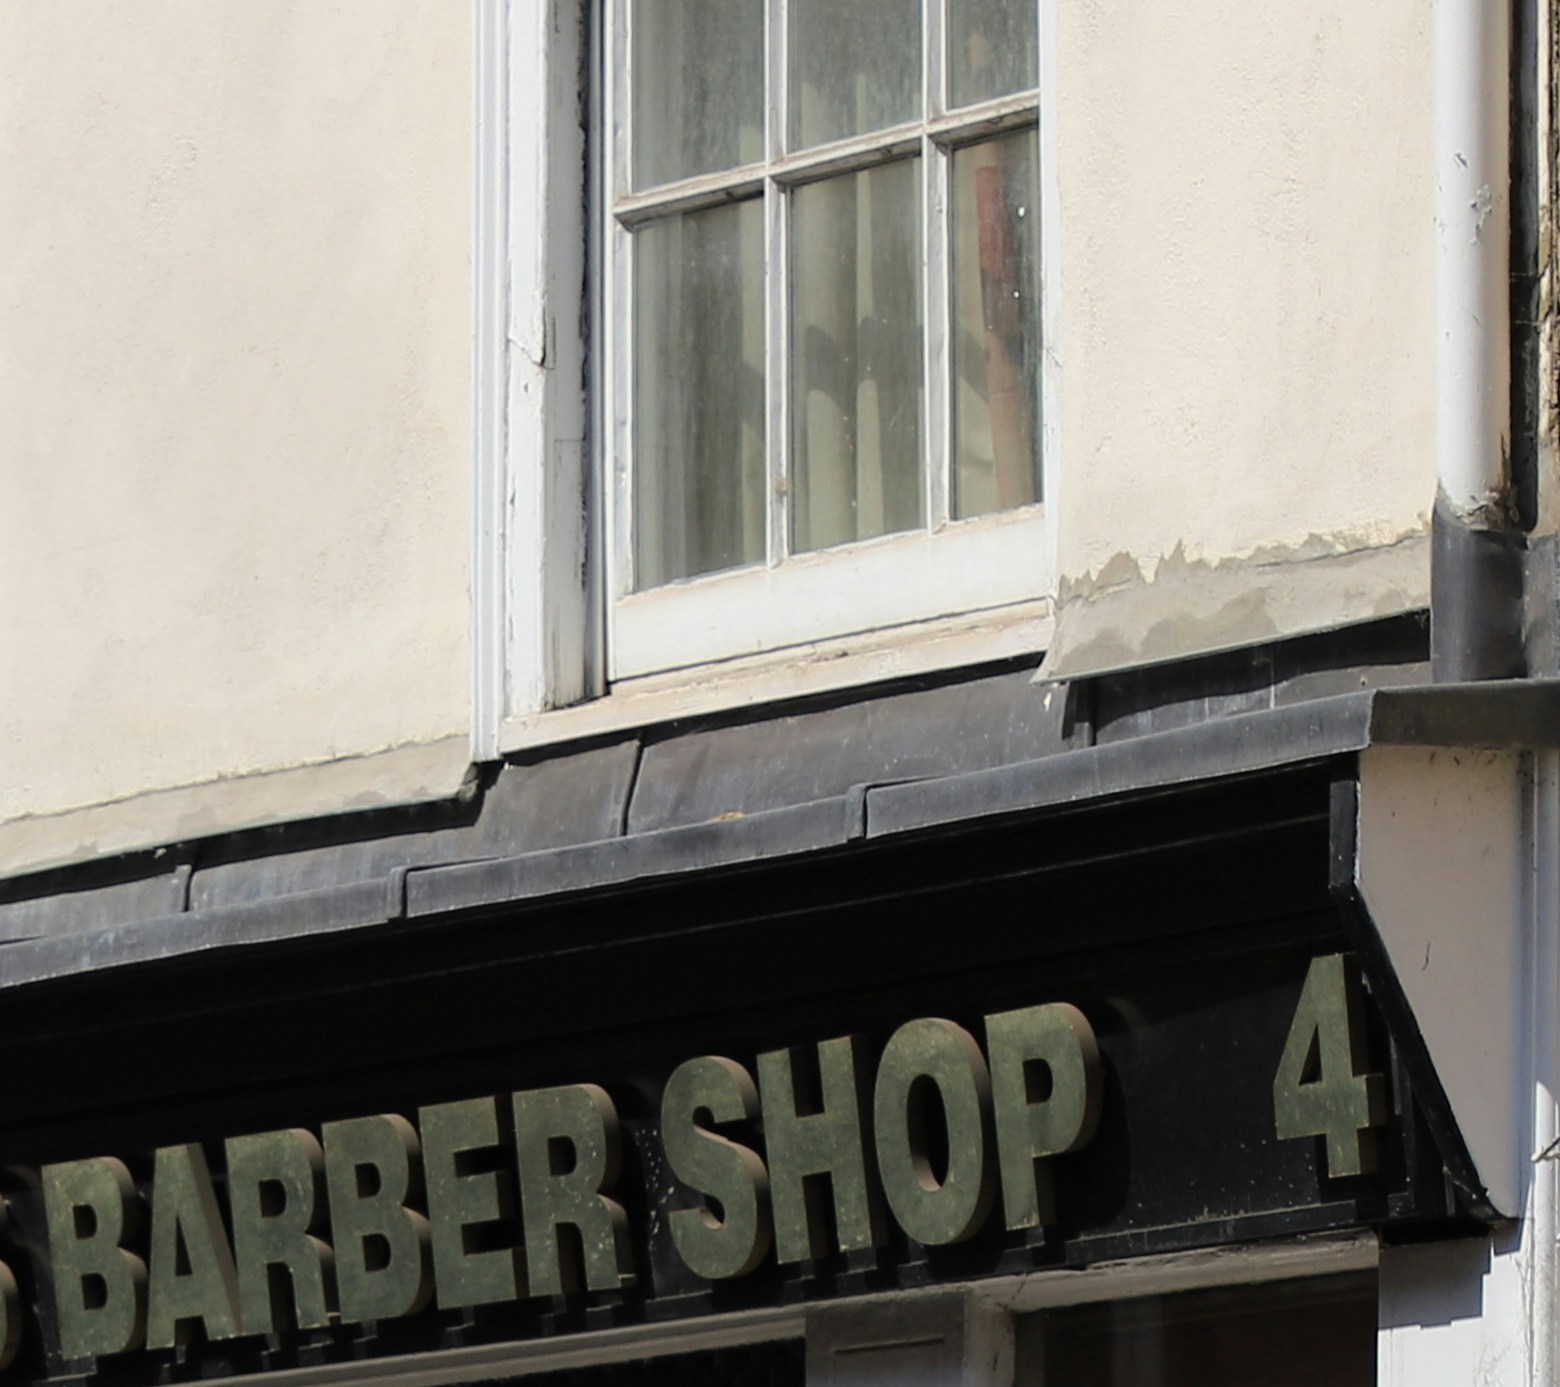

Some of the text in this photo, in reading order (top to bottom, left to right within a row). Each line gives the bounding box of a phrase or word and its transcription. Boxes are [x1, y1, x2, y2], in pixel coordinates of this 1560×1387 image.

[41, 1082, 637, 1361] BARBER
[661, 1001, 1103, 1280] SHOP
[1274, 953, 1387, 1178] 4
